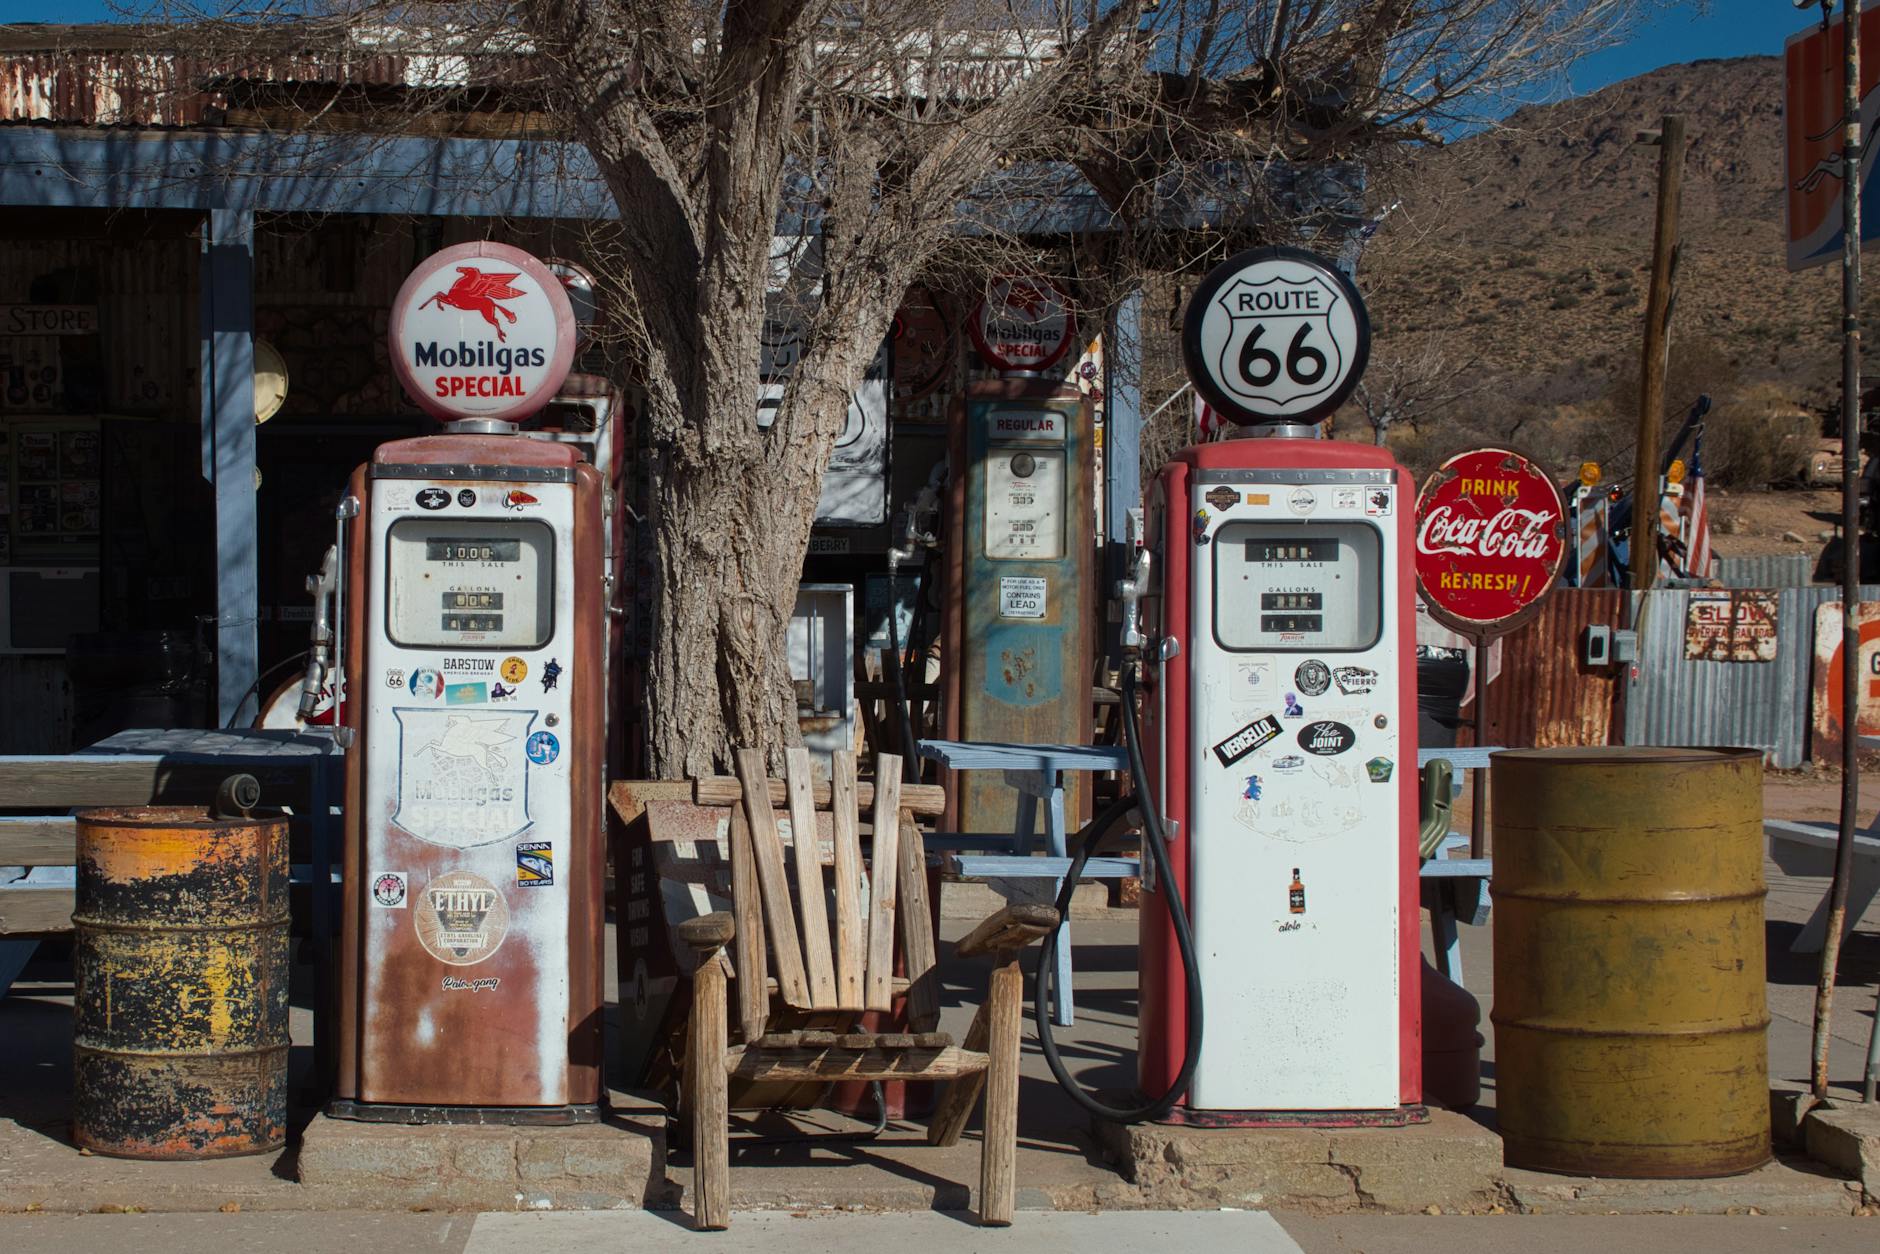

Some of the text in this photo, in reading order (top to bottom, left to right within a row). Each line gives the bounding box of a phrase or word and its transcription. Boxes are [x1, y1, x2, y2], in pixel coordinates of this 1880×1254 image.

[1238, 290, 1320, 312] ROUTE
[8, 307, 91, 333] STORE
[986, 324, 1061, 344] Mobilgas
[415, 340, 545, 375] Mobilgas
[997, 344, 1050, 357] SPECIAL
[1239, 320, 1327, 388] 66
[435, 376, 526, 398] SPECIAL
[996, 419, 1054, 431] REGULAR
[1460, 478, 1520, 497] DRINK
[1416, 505, 1557, 558] Coca-Cola
[1010, 600, 1036, 609] LEAD
[443, 658, 495, 671] BARSTOW
[389, 677, 402, 686] 66
[1347, 678, 1377, 686] FIERRO
[1313, 721, 1341, 738] The
[1309, 736, 1344, 749] JOINT
[517, 842, 551, 852] SENNA
[530, 879, 553, 887] YEARS
[434, 891, 490, 912] ETHYL
